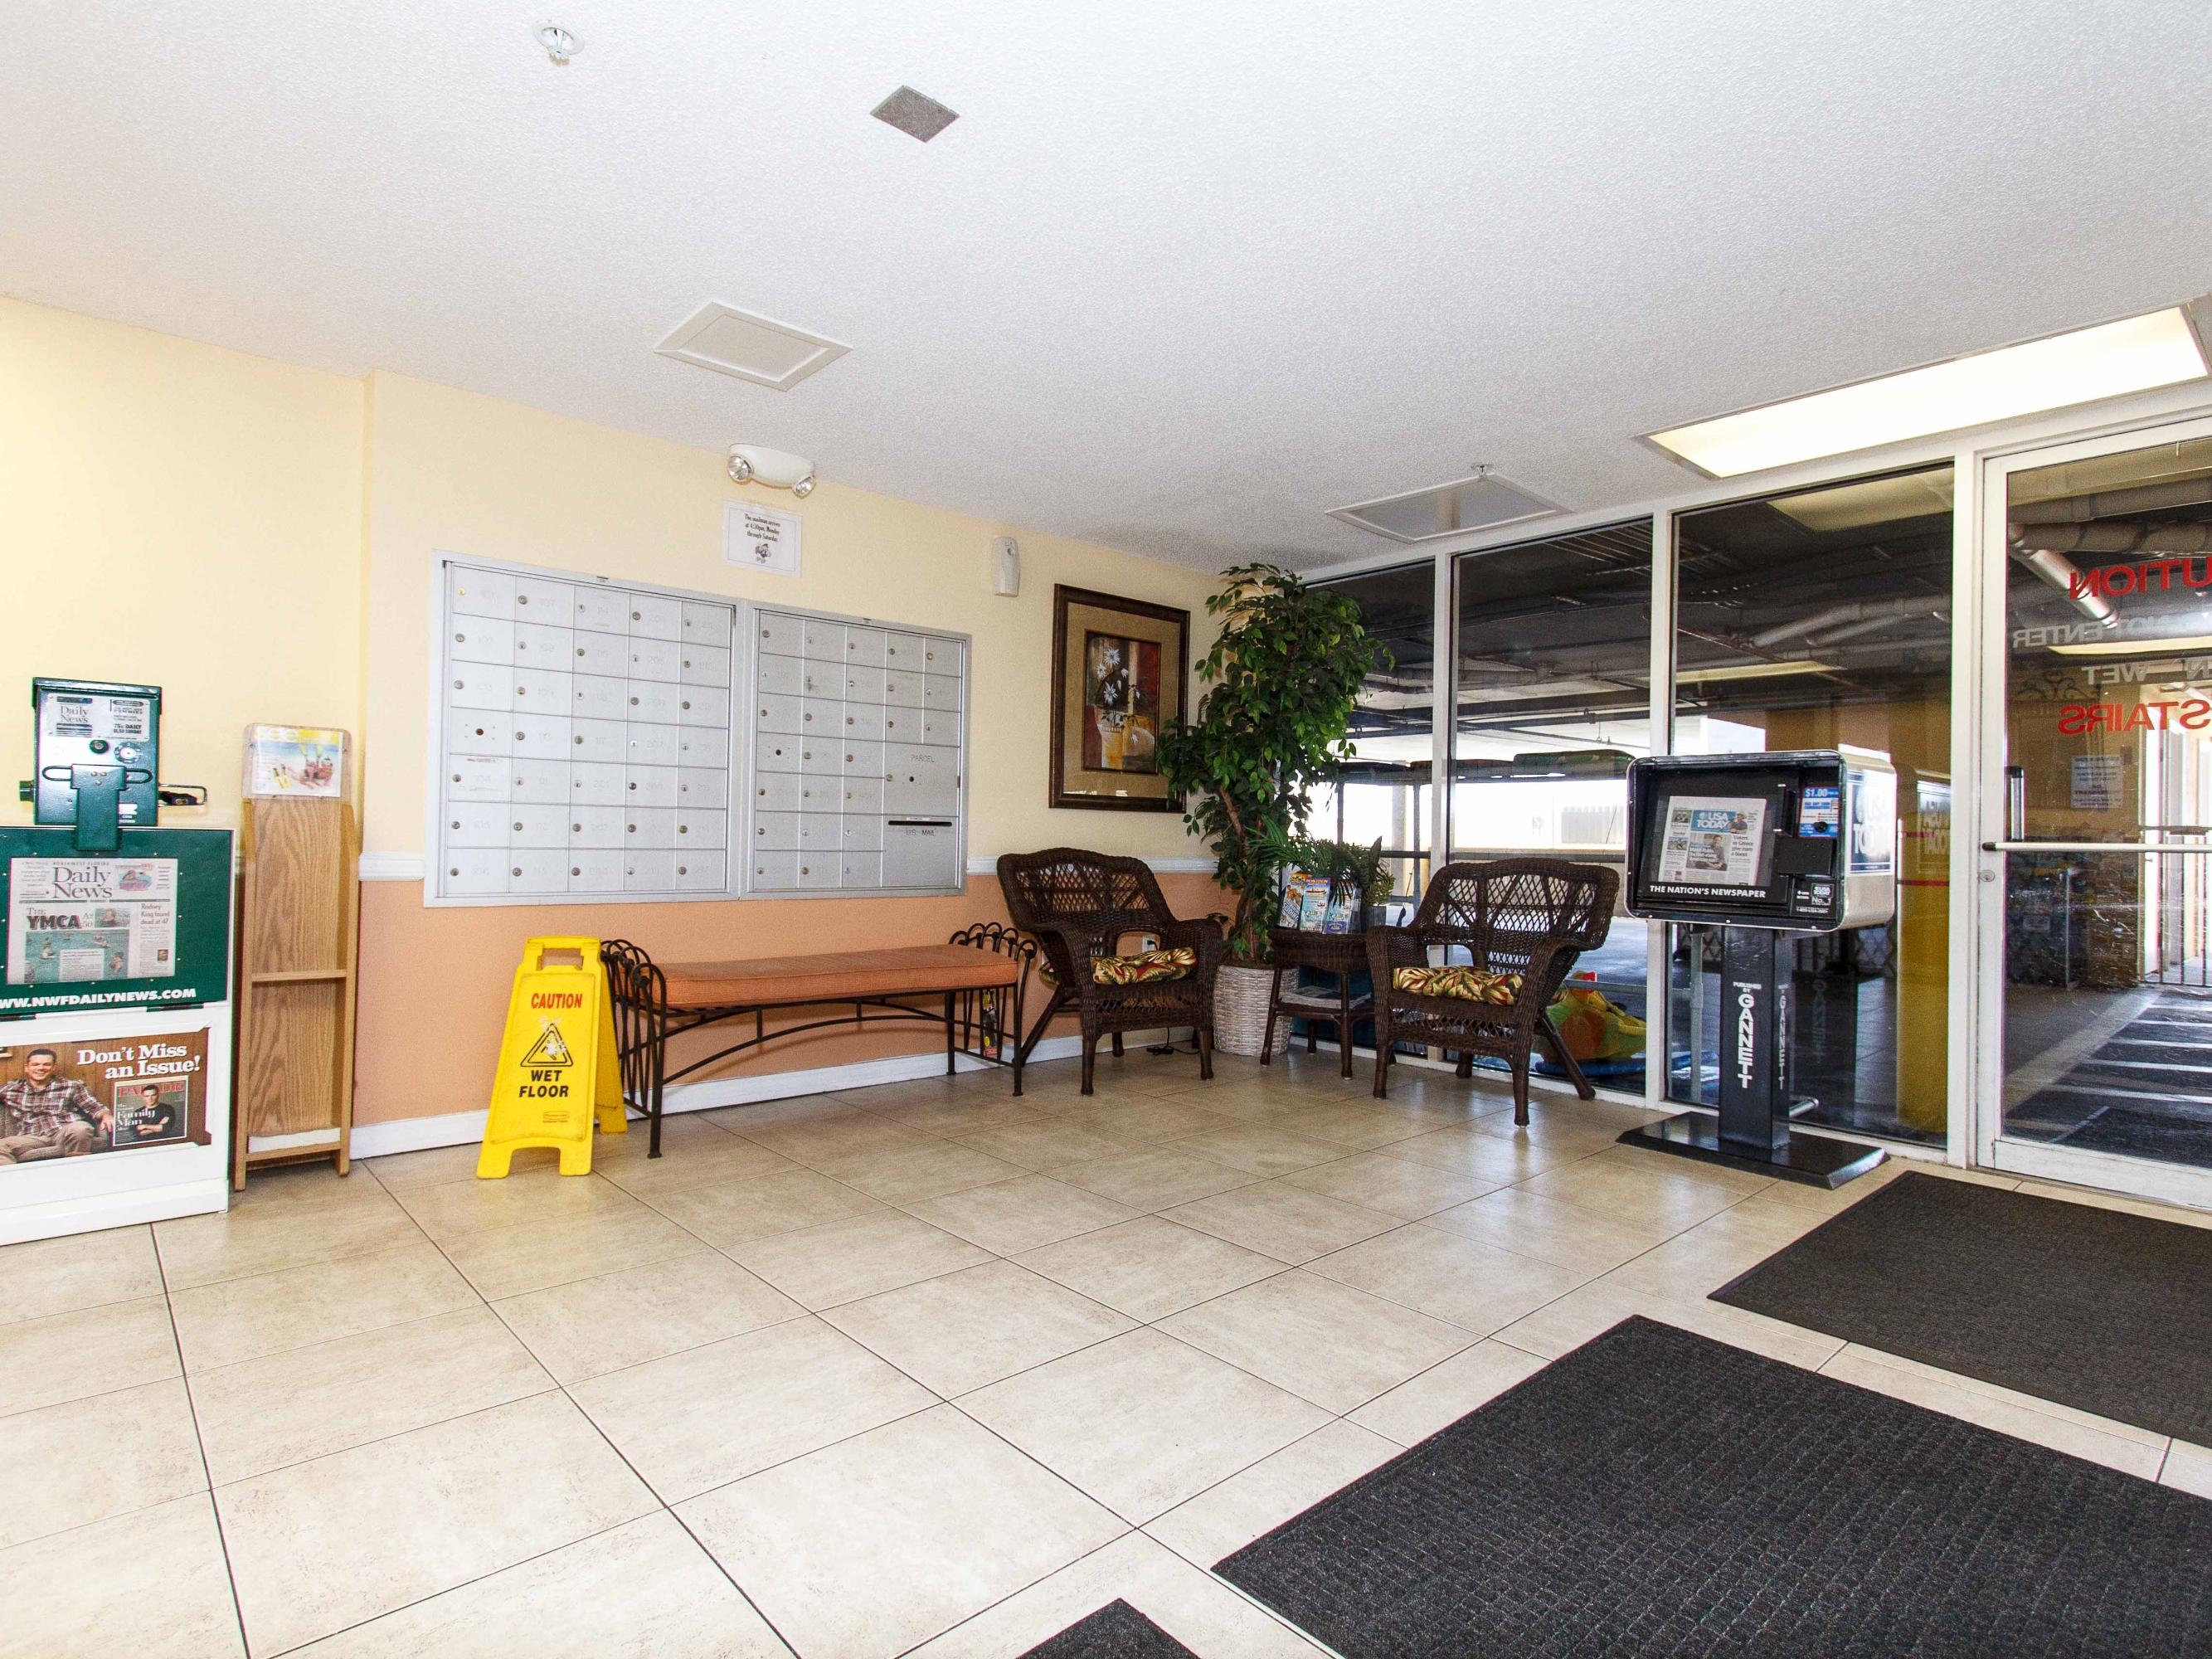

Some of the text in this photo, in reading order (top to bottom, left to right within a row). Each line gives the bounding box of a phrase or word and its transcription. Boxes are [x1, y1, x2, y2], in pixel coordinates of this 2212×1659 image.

[61, 705, 89, 716] Daily
[61, 714, 89, 723] News
[911, 754, 936, 763] PARCEL
[1805, 788, 1828, 797] $1.00
[1709, 812, 1729, 821] USA
[1697, 820, 1730, 829] TODAY
[52, 866, 111, 888] Daily
[52, 883, 113, 899] News
[1650, 885, 1767, 898] THE NATION'S NEWSPAPER
[27, 915, 82, 930] YMCA
[531, 992, 583, 1009] CAUTION
[1738, 994, 1755, 1089] GANNETT
[77, 1043, 187, 1065] Don't Miss
[105, 1054, 201, 1079] an Issue!
[531, 1070, 562, 1082] WET
[518, 1085, 570, 1097] FLOOR
[117, 1108, 155, 1119] Family
[117, 1118, 143, 1127] Man
